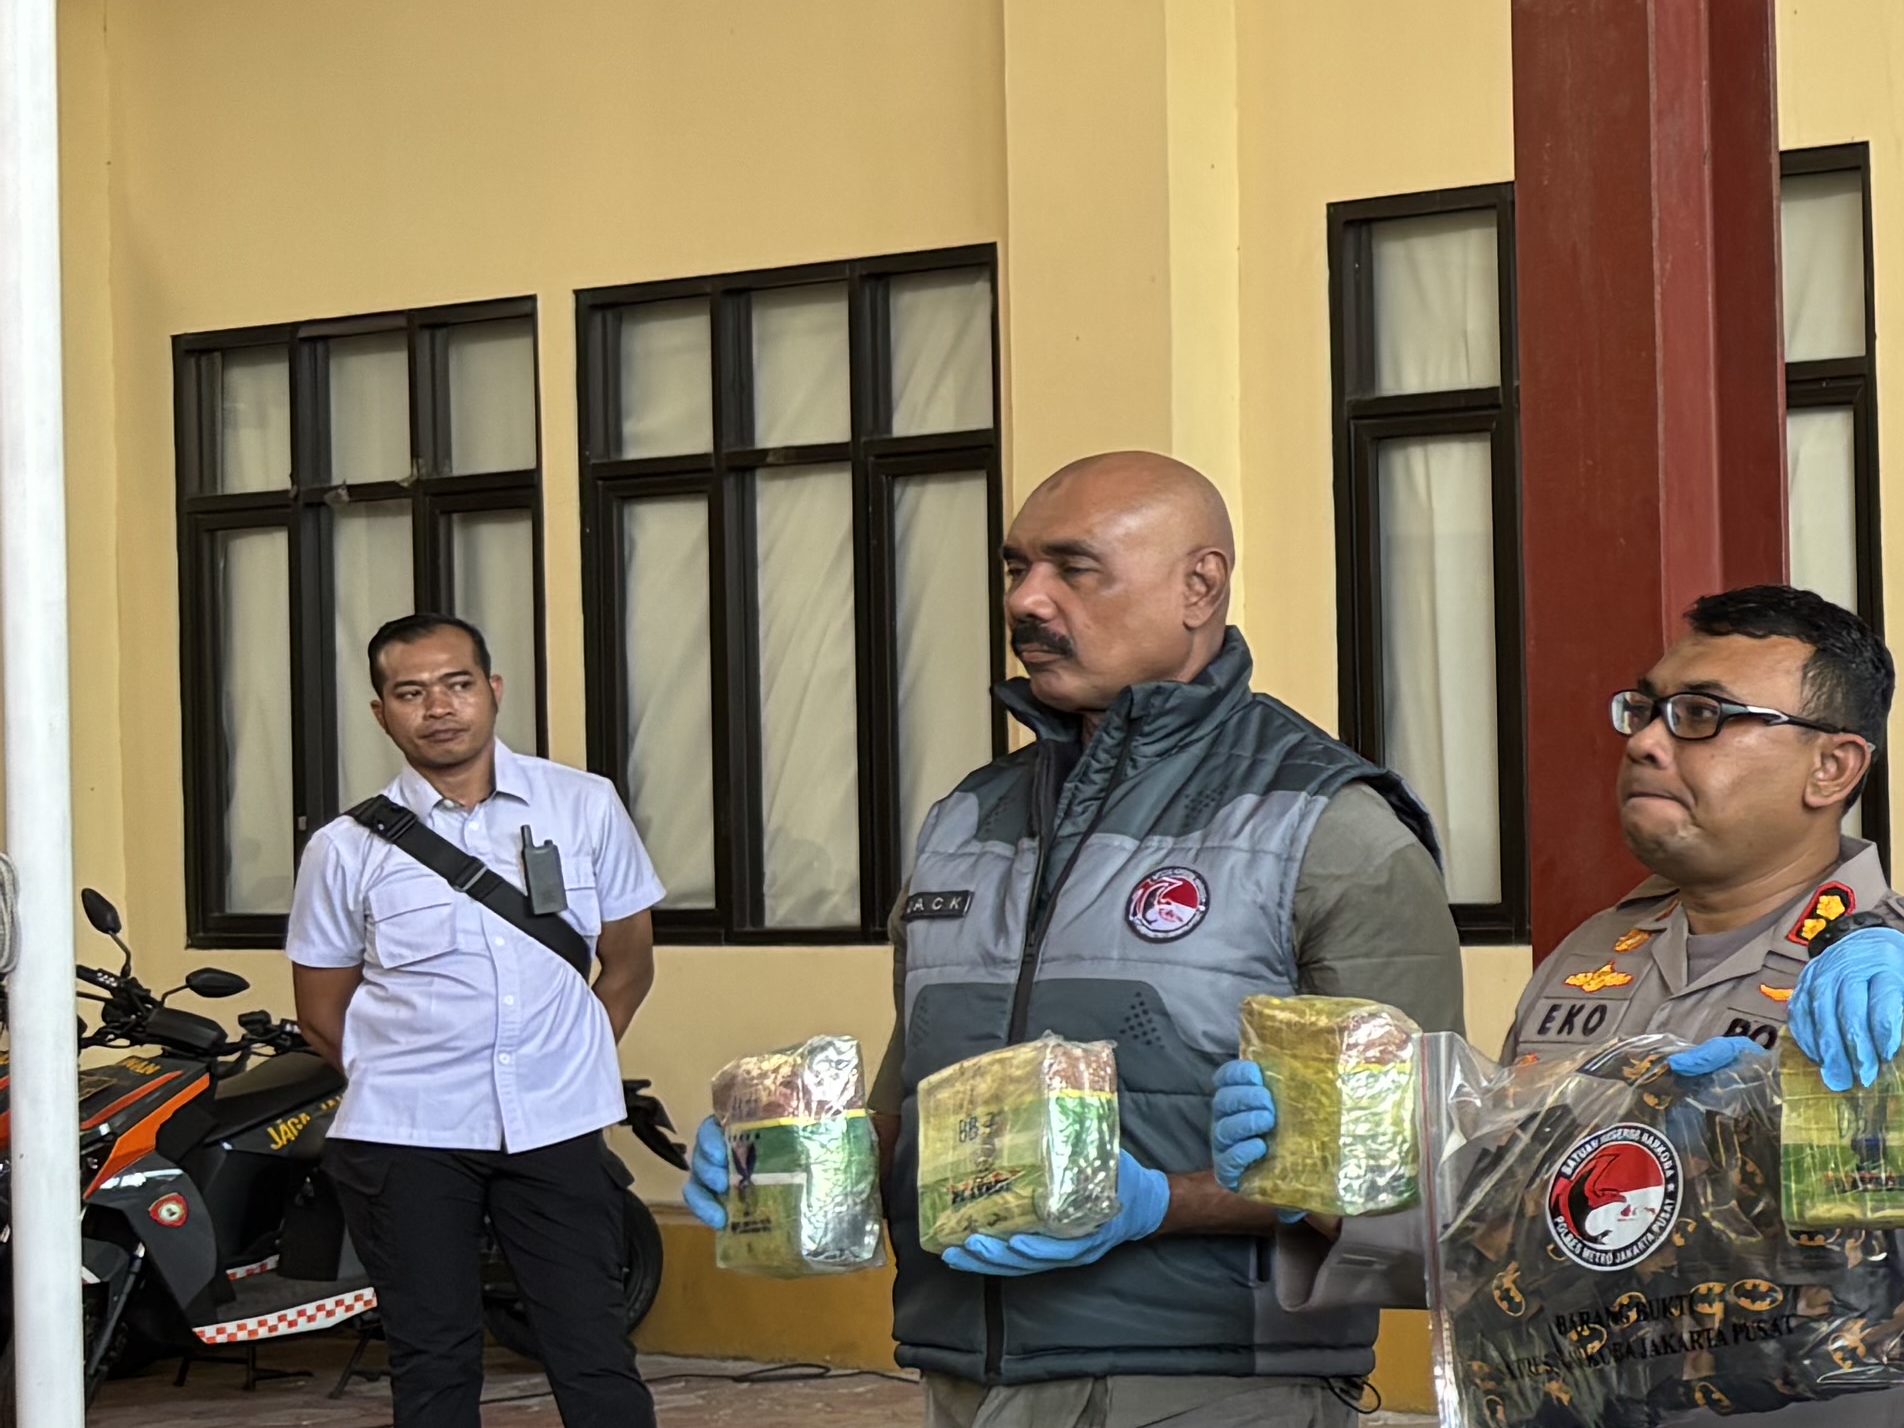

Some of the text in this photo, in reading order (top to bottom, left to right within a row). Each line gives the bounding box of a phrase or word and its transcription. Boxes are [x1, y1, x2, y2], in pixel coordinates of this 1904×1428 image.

[1536, 1002, 1608, 1036] EKO
[1553, 1198, 1676, 1266] POLRES METRO JAKARTA PUSAT
[1732, 1315, 1795, 1345] PUSAT
